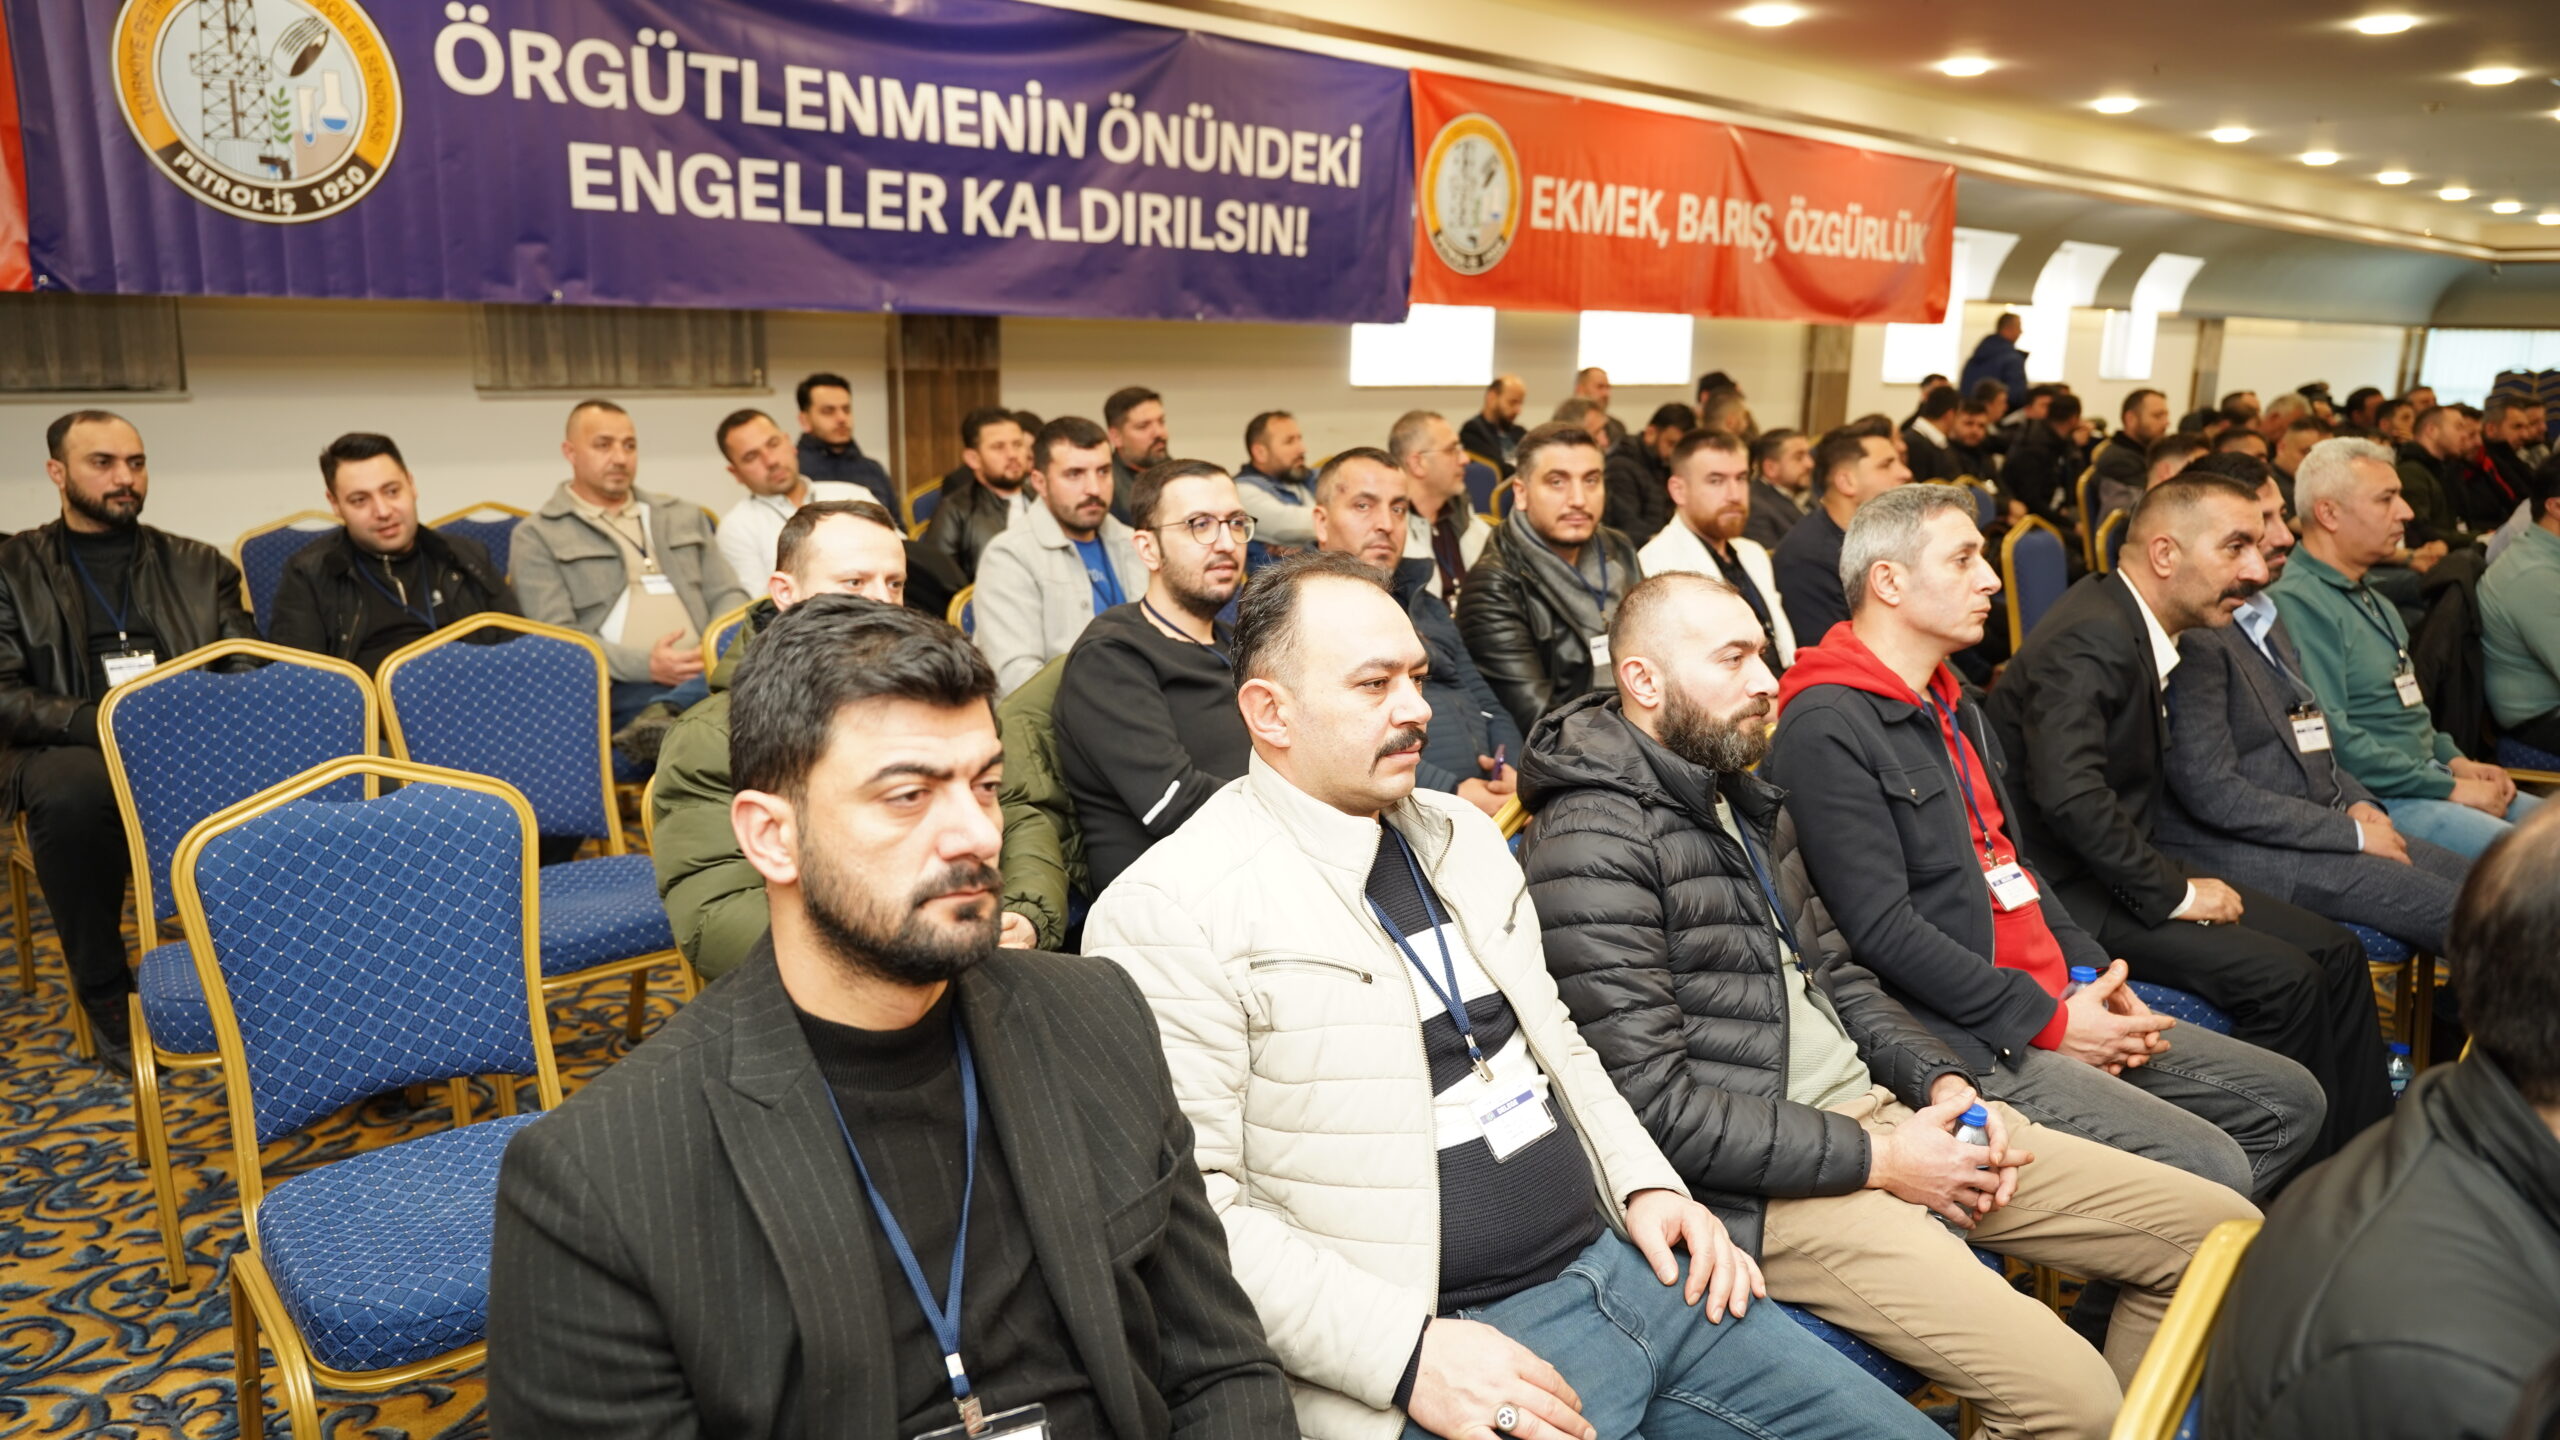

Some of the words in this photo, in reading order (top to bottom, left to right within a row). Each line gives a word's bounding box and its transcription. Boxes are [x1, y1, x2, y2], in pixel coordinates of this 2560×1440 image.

[434, 1, 1087, 158] ÖRGÜTLENMENİN
[1099, 91, 1362, 188] ÖNÜNDEKİ
[172, 149, 297, 216] PETROL-İŞ
[310, 165, 367, 208] 1950
[567, 141, 948, 234] ENGELLER
[962, 177, 1309, 258] KALDIRILSIN!
[1530, 175, 1670, 248] EKMEK,
[1676, 192, 1778, 264] BARIŞ,
[1784, 195, 1927, 265] ÖZGÜRLÜK
